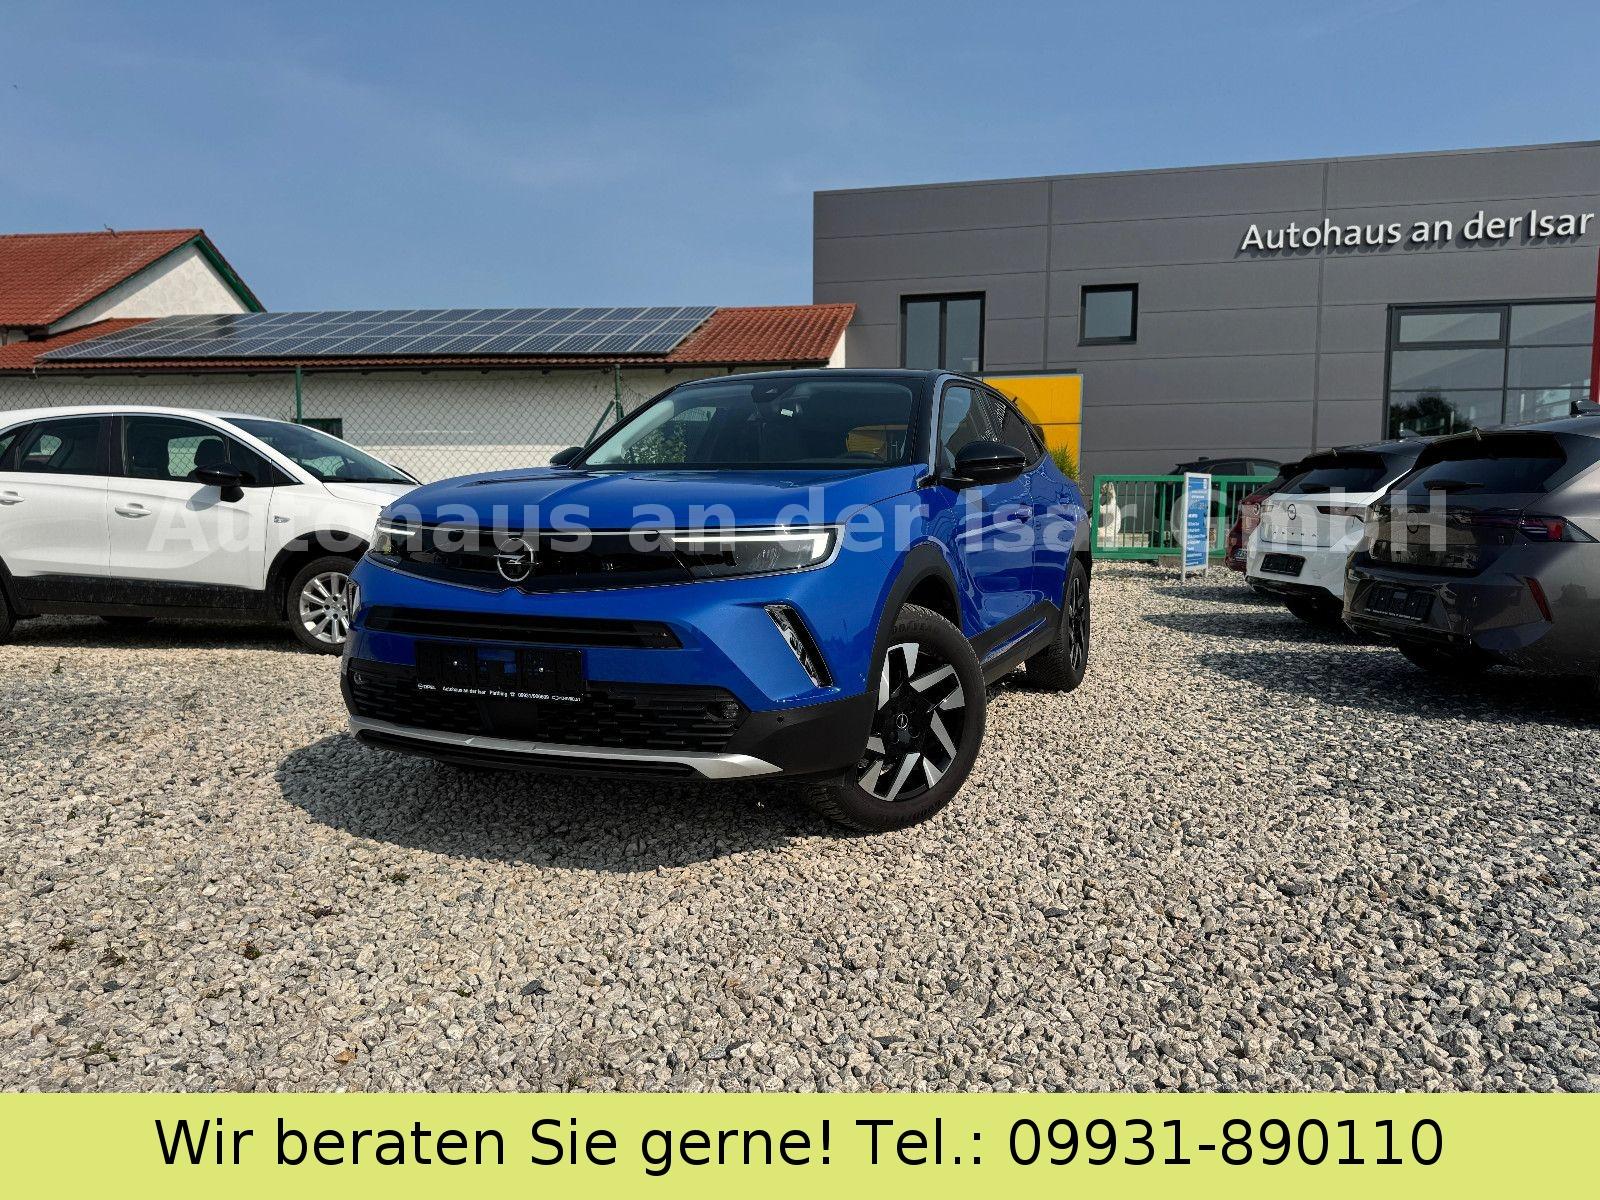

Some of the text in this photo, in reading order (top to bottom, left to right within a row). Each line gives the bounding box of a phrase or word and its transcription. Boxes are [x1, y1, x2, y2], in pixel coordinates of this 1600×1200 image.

[1241, 209, 1595, 250] Autohaus an der Isar
